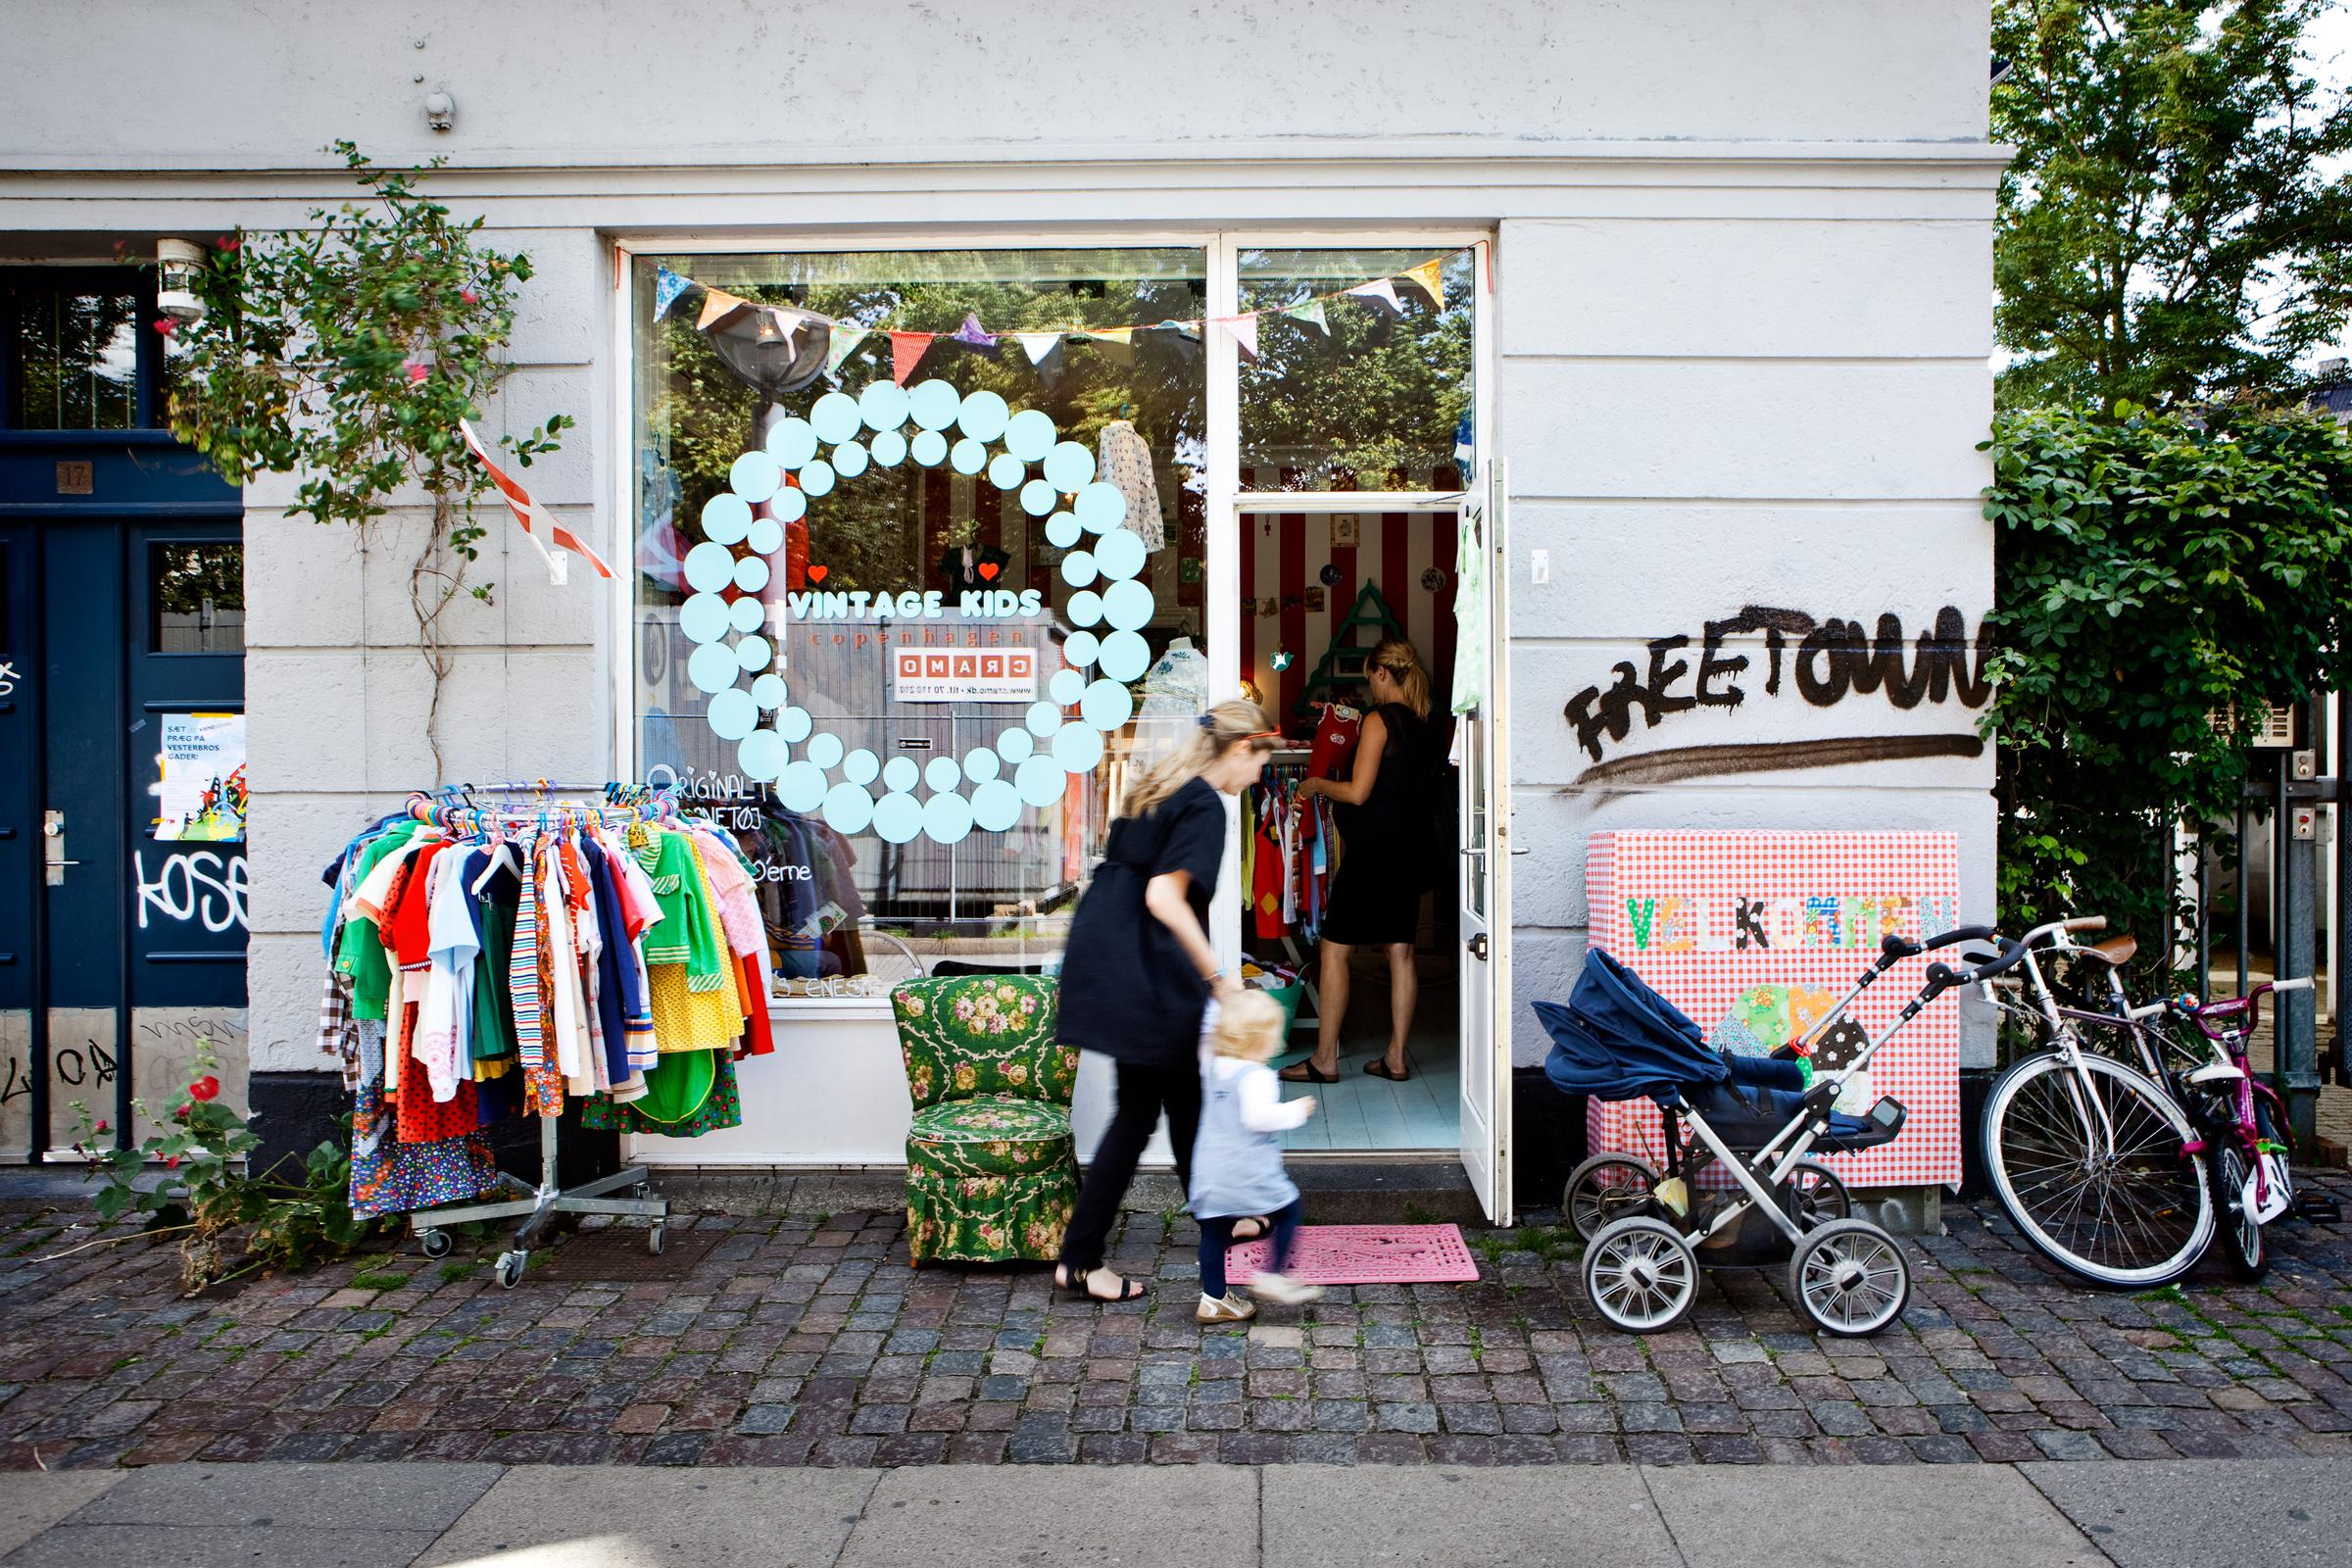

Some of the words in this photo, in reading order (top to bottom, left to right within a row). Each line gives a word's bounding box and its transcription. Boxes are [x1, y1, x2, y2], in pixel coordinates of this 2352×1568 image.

[63, 466, 84, 487] 17
[787, 590, 944, 619] VINTAGE
[960, 589, 1042, 618] KIDS
[1626, 896, 1955, 952] VELKOMMEN
